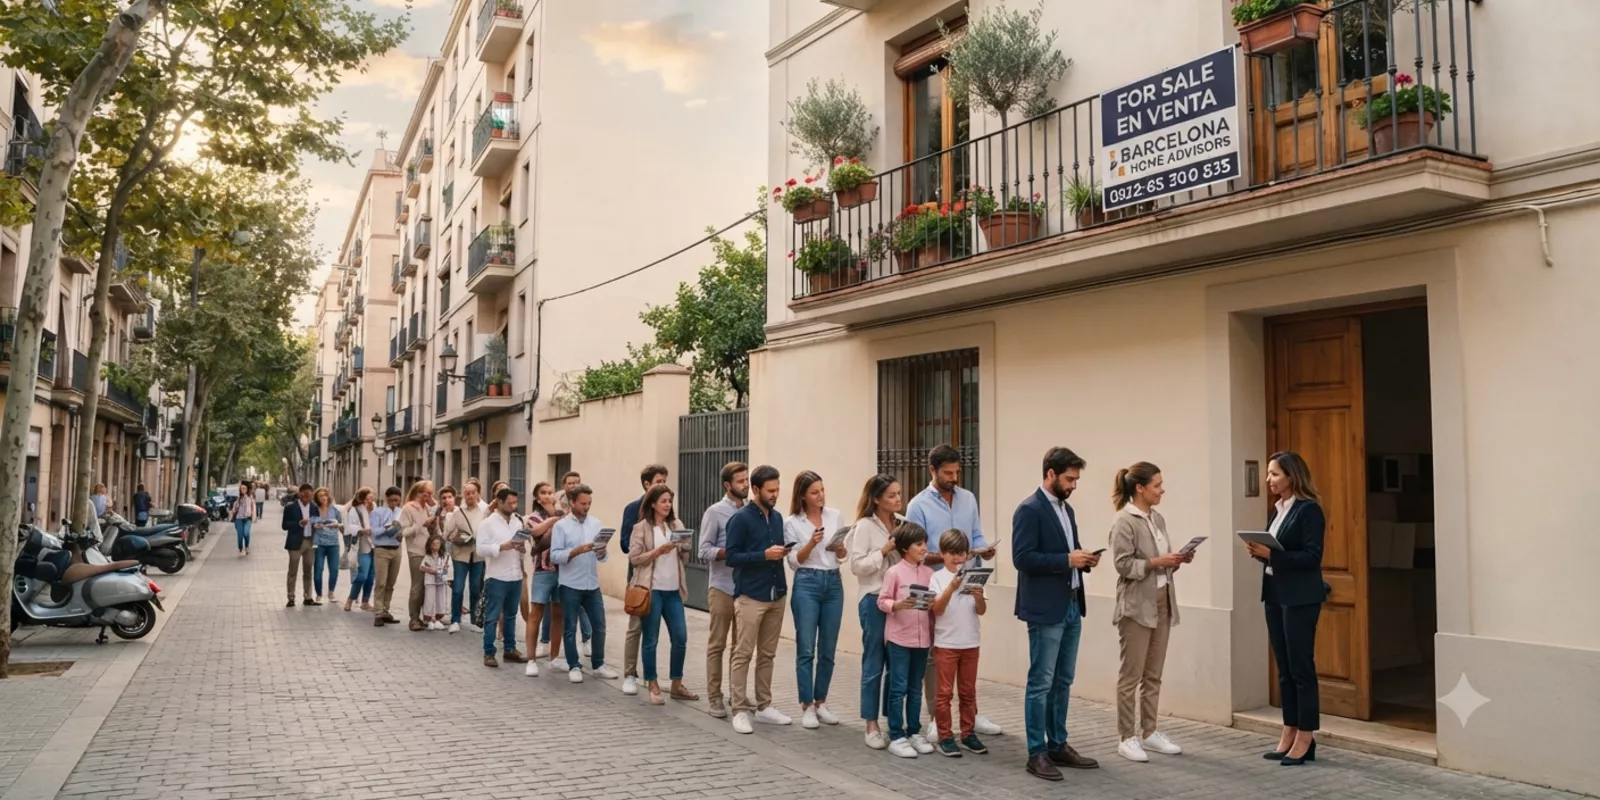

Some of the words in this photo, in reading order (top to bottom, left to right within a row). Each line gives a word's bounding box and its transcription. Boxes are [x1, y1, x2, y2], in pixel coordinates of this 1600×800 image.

[1117, 83, 1156, 113] FOR
[1161, 61, 1214, 96] SALE
[1117, 111, 1142, 136] EN
[1147, 88, 1217, 125] VENTA
[1121, 116, 1230, 163] BARCELONA
[1167, 135, 1231, 164] ADVISORS
[1168, 167, 1199, 188] 300
